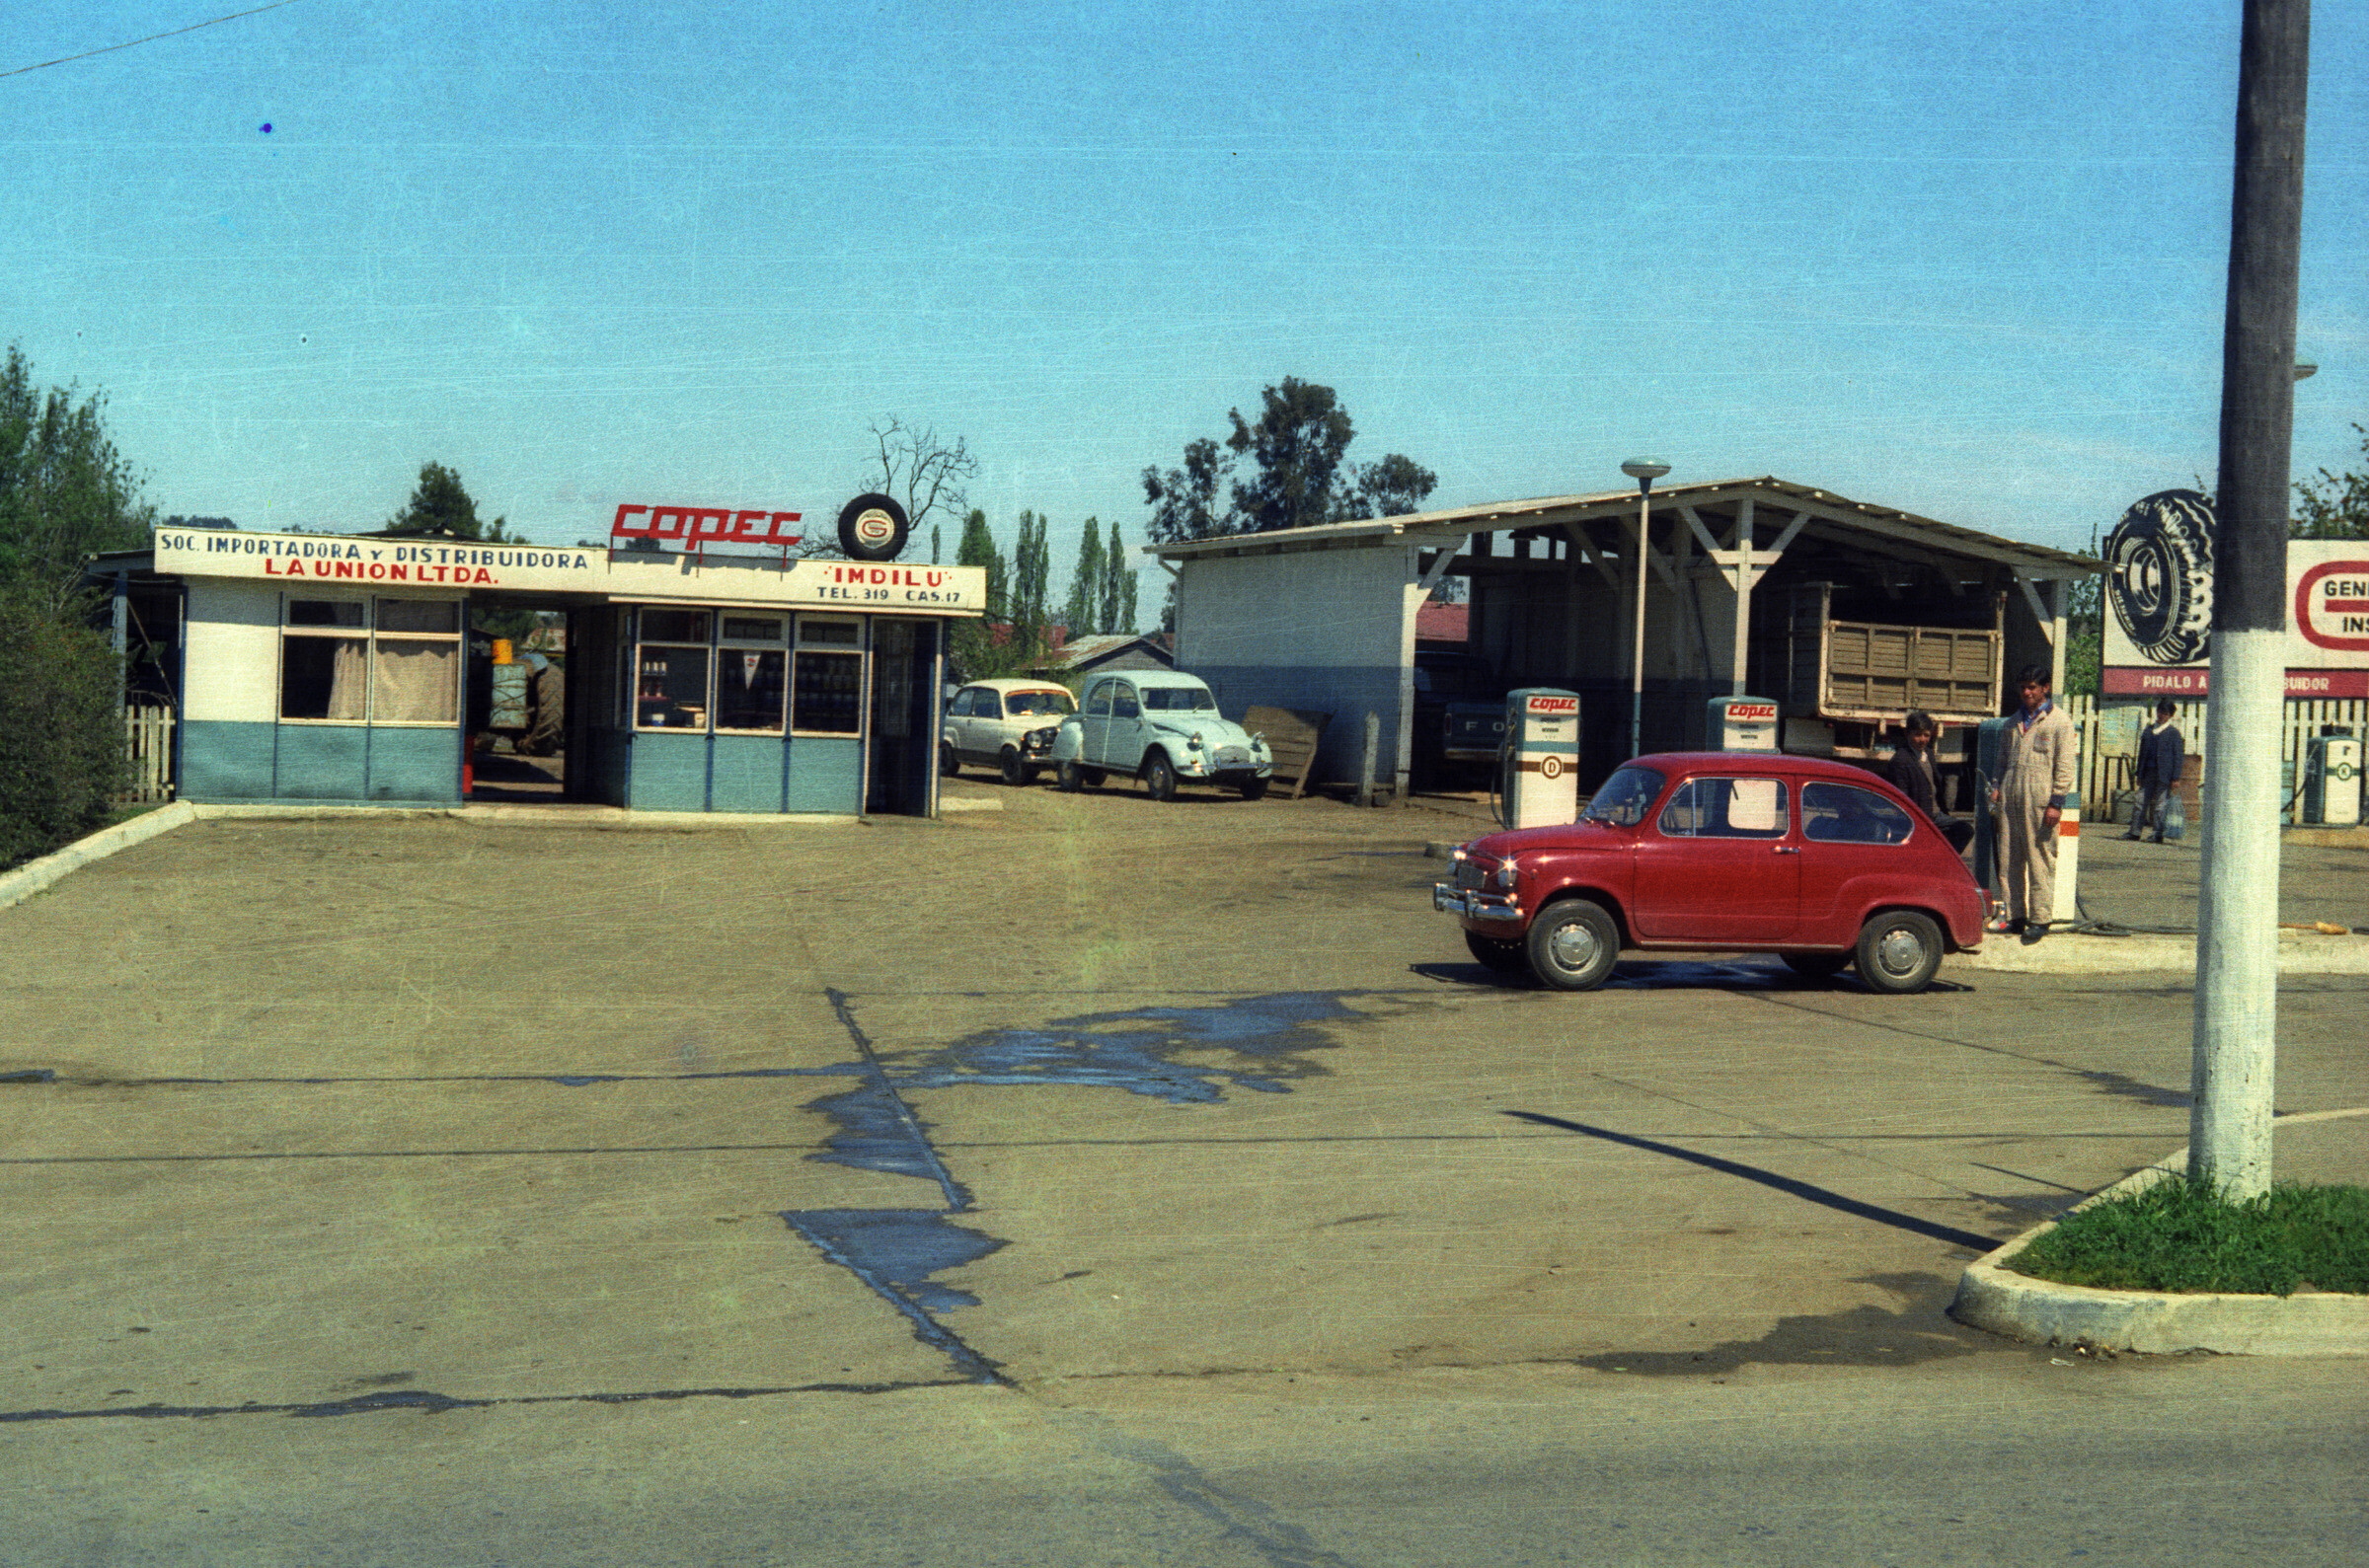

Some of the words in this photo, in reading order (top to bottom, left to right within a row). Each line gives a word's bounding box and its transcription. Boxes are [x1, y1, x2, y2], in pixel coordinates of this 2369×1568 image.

[161, 534, 200, 552] SOC.
[207, 537, 361, 560] IMPORTADORA
[396, 547, 588, 569] DISTRIBUIDORA
[265, 559, 306, 576] LA
[315, 560, 408, 580] UNION
[417, 564, 498, 584] LTDA.
[817, 586, 858, 599] TEL.
[864, 588, 888, 600] 319
[2325, 580, 2369, 597] GEN
[2143, 675, 2191, 689] PIDALO
[1465, 721, 1505, 733] FO
[1548, 762, 1557, 774] D
